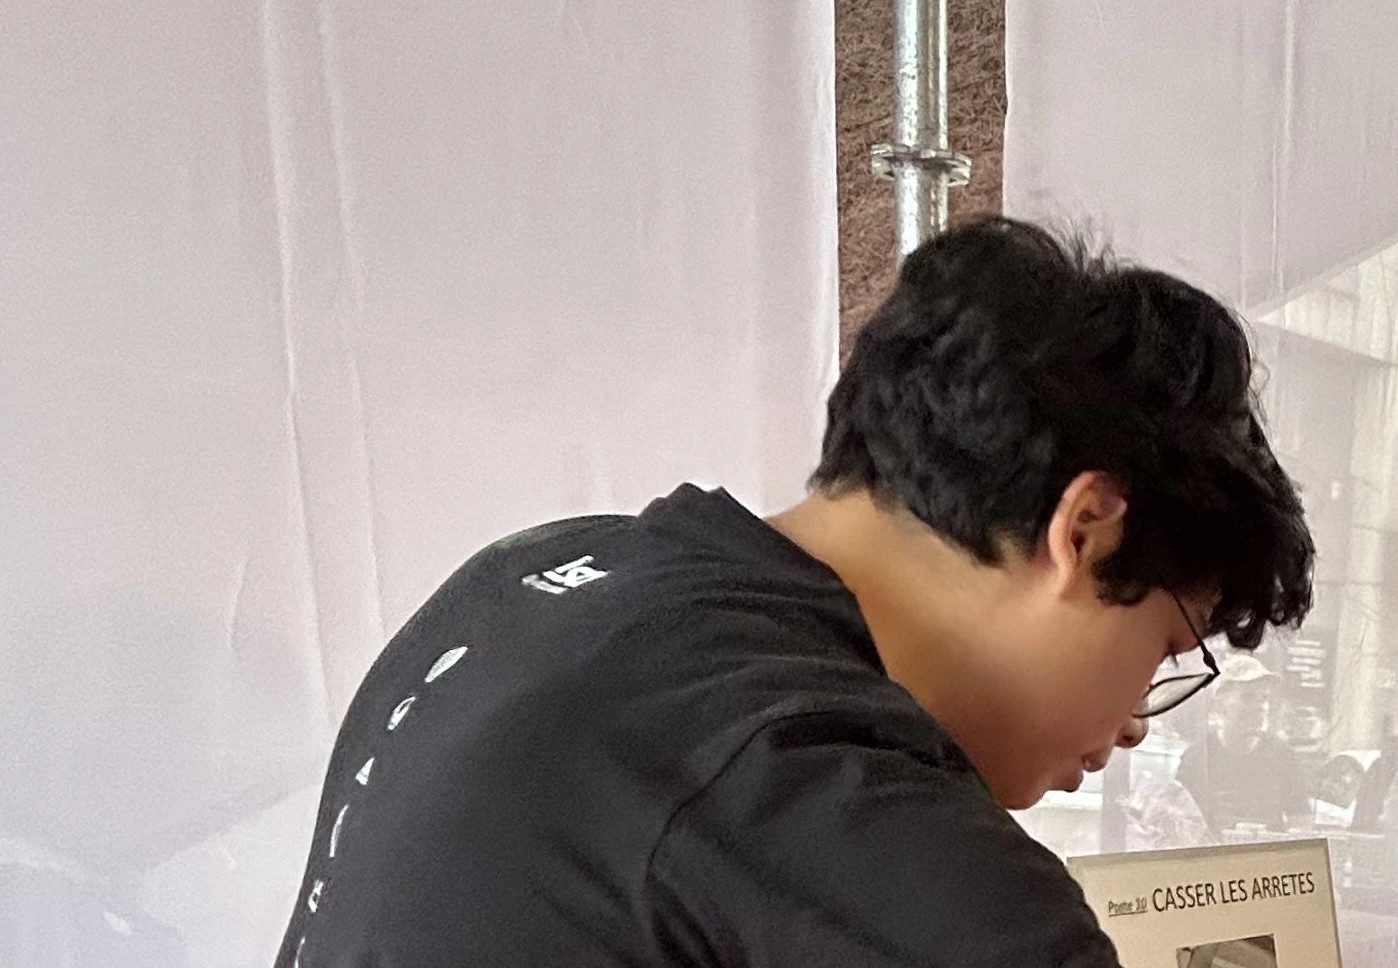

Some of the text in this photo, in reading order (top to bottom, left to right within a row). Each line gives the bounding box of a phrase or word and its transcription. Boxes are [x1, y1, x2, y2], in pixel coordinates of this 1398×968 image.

[1152, 882, 1217, 912] CASSER
[1220, 879, 1248, 904] LES
[1251, 871, 1315, 900] ARRETES
